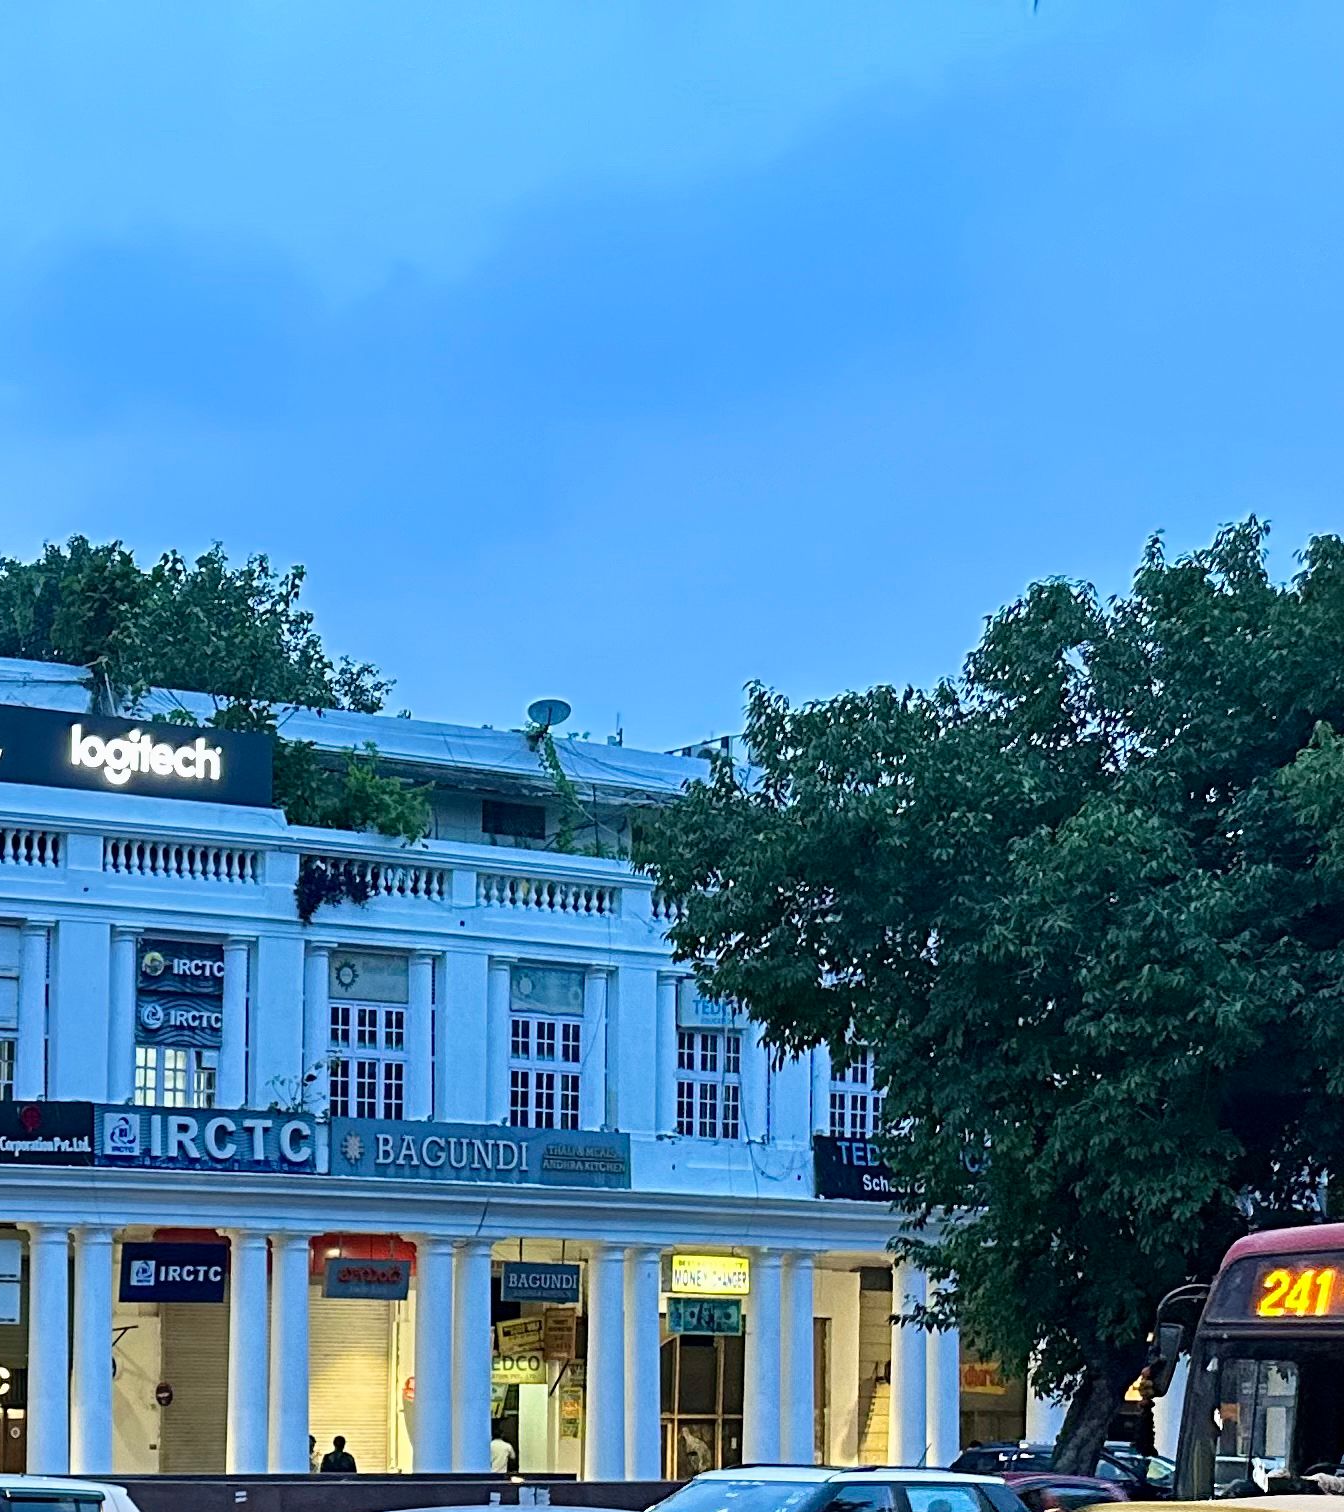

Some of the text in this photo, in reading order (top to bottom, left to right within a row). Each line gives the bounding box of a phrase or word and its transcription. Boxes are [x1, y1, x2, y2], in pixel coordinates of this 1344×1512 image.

[70, 723, 222, 785] logitech
[171, 957, 225, 978] IRCTC
[168, 1007, 223, 1030] IRCTC
[150, 1113, 312, 1163] IRCTC
[375, 1133, 529, 1172] BAGUNDI
[159, 1265, 223, 1283] IRCTC
[508, 1273, 578, 1289] BAGUNDI
[1256, 1267, 1337, 1318] 241
